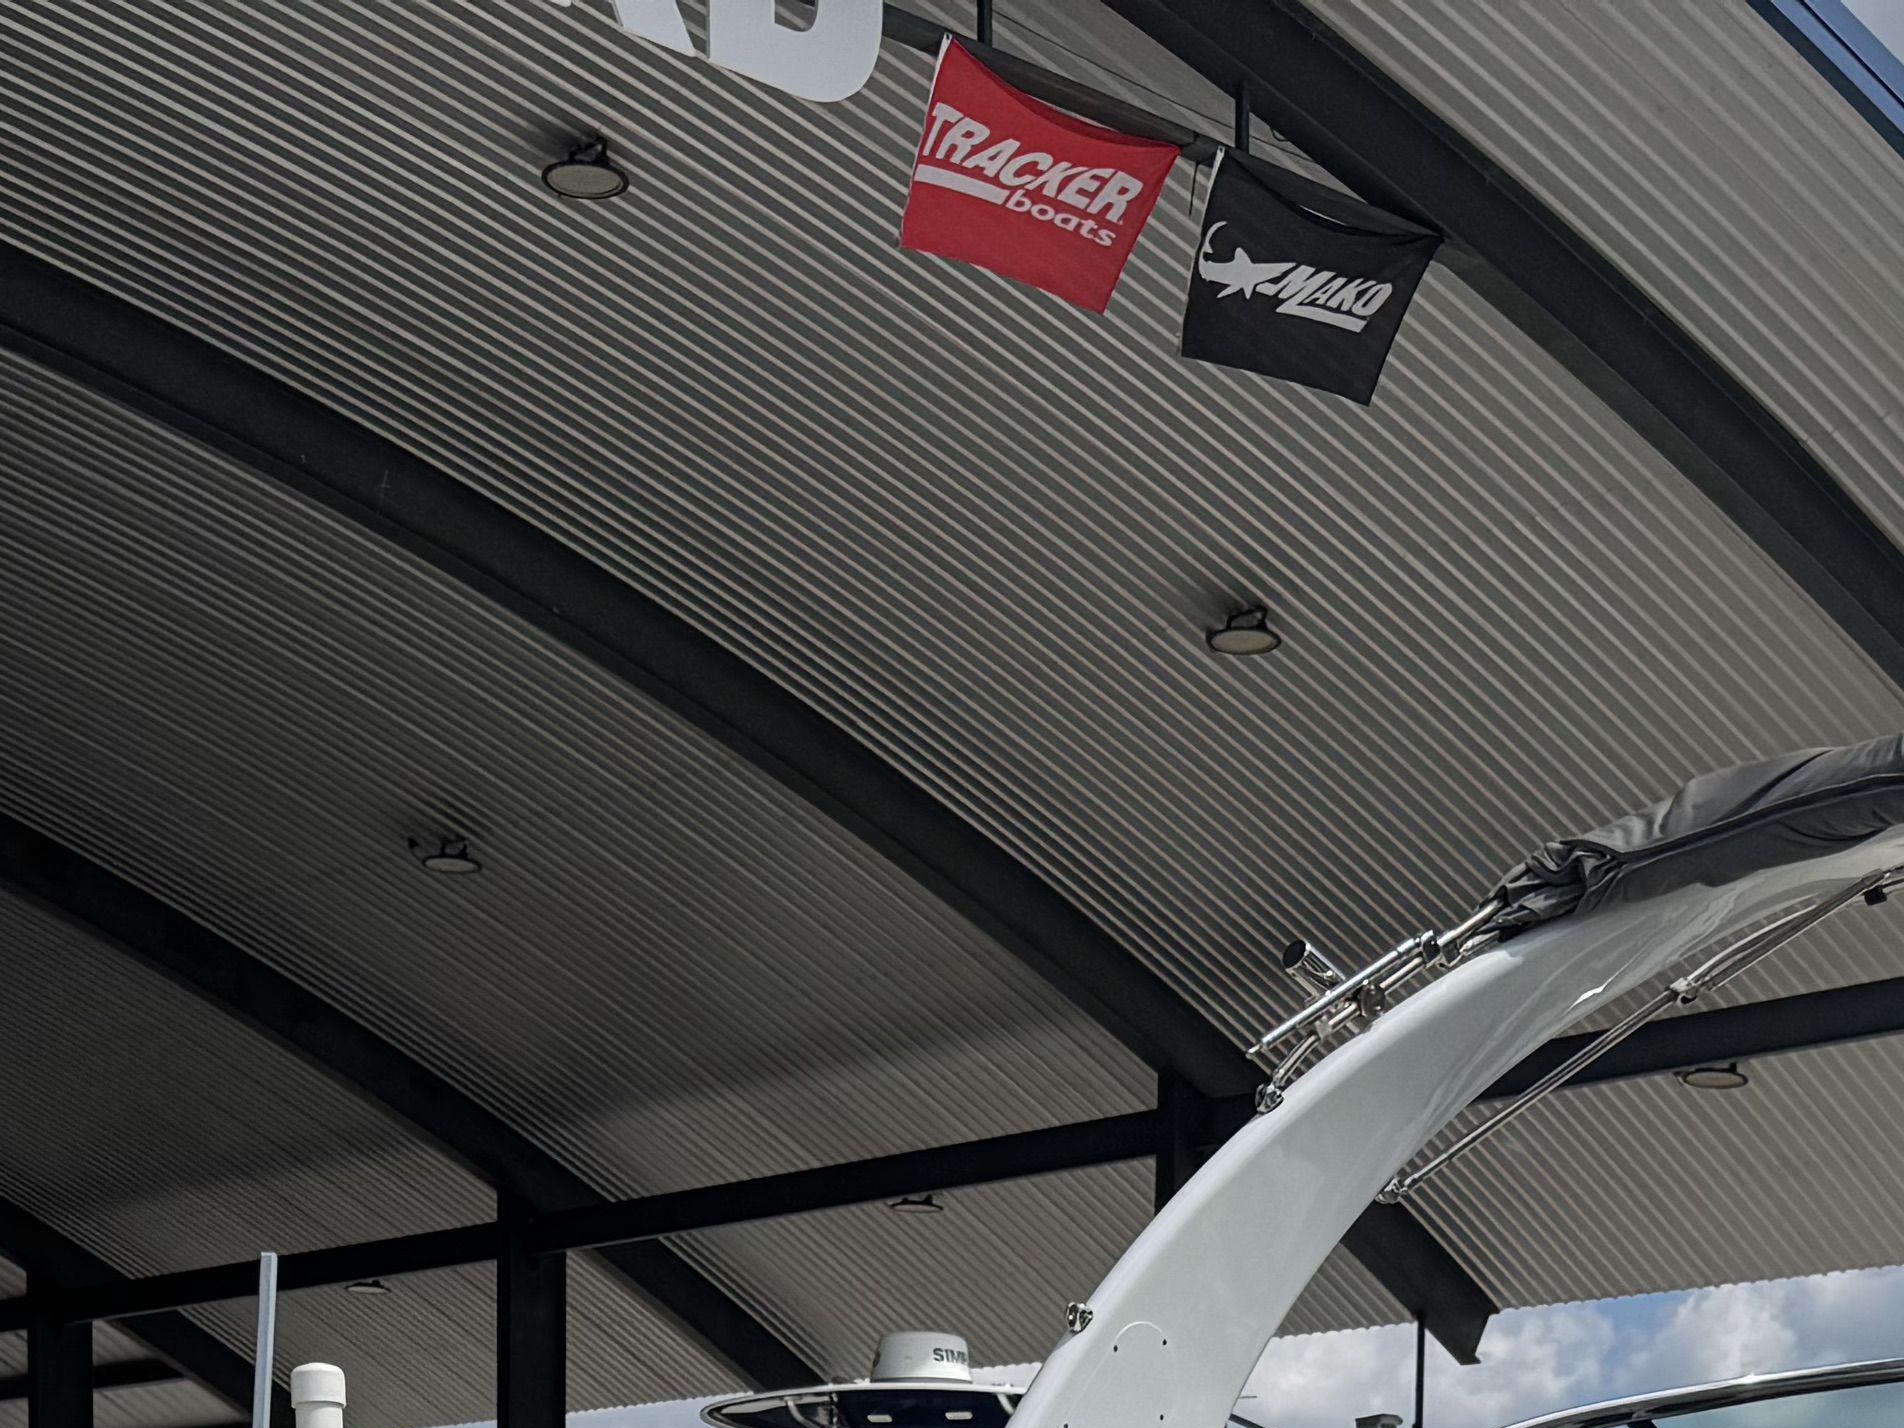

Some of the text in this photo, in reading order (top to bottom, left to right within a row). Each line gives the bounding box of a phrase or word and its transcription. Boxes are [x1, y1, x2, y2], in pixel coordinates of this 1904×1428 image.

[922, 101, 1145, 223] TRACKER
[1002, 188, 1117, 248] boats
[1260, 263, 1394, 332] MAKO
